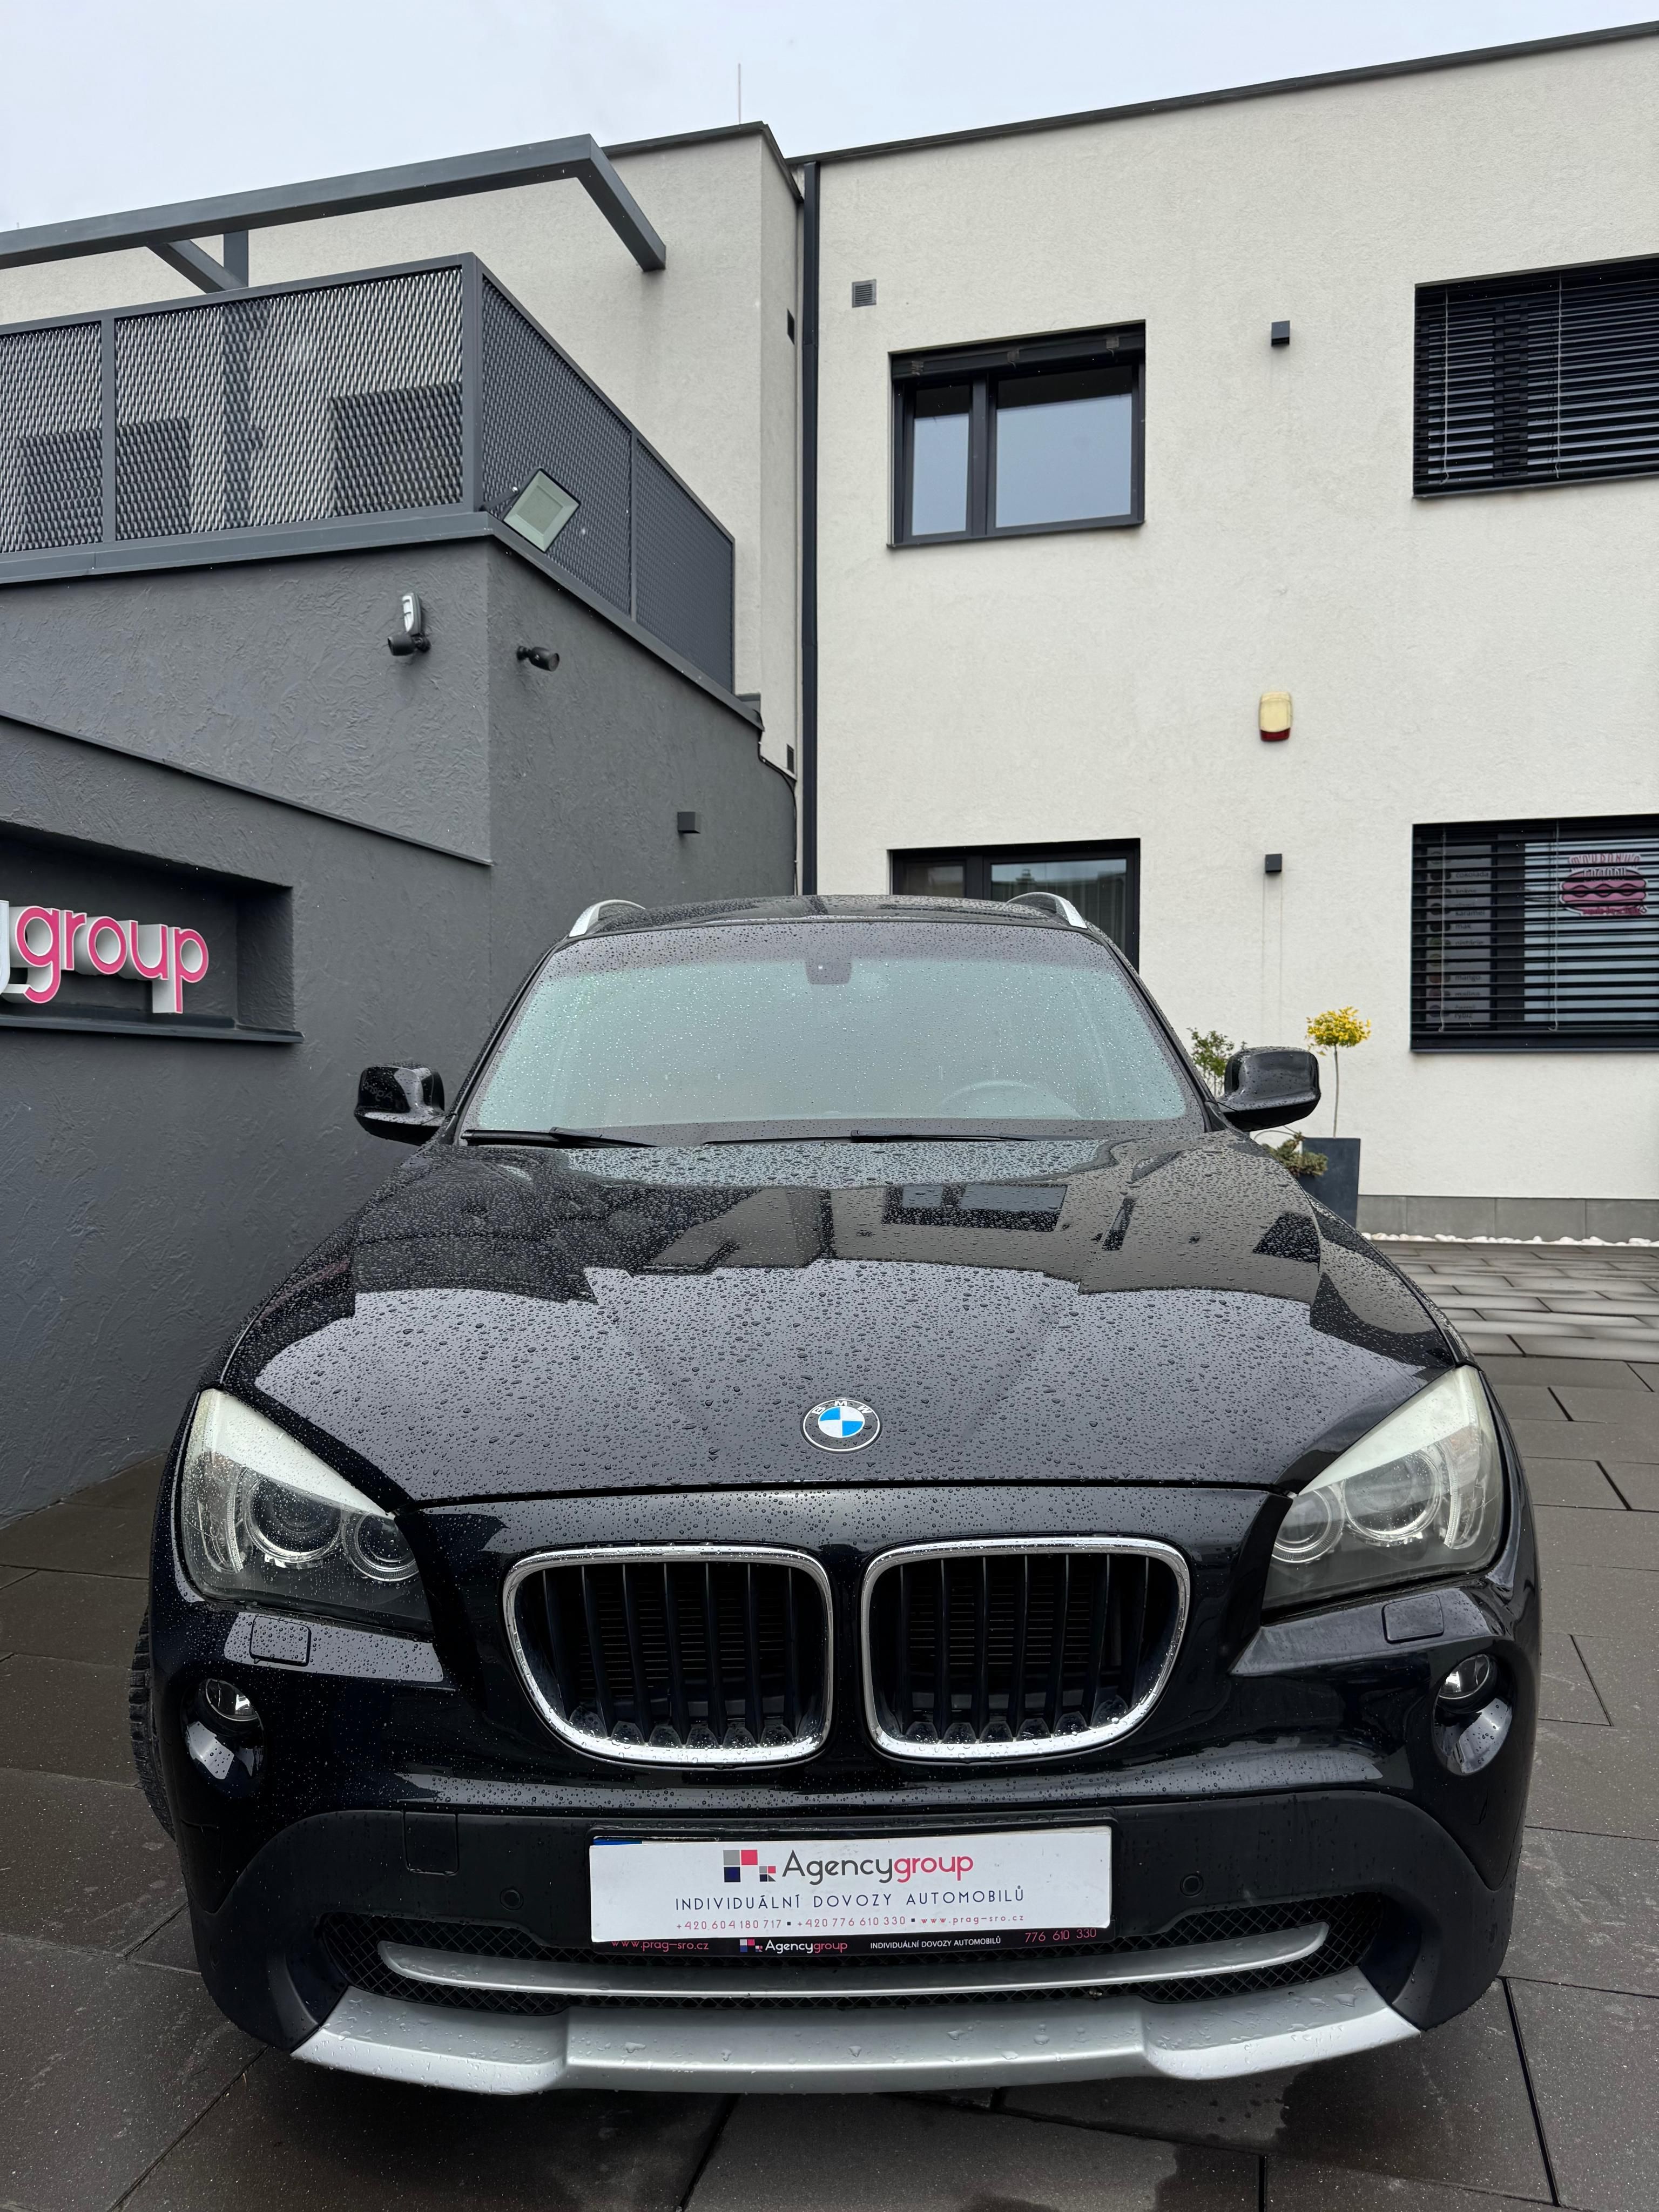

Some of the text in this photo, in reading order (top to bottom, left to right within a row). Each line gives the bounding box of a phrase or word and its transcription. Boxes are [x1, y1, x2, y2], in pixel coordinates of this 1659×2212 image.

[811, 1400, 873, 1415] BMW
[782, 1849, 974, 1885] Agencygroup
[676, 1885, 1023, 1910] INDIVIDUÁLNÍ DOVOZY AUTOMOBILŮ
[832, 1917, 854, 1927] 776
[860, 1917, 879, 1926] 610
[884, 1916, 905, 1925] 330
[921, 1915, 1024, 1925] www.prag-sro.cz
[870, 1935, 1001, 1949] INDIVIDUÁLNÍ DOVOZY AUTOMOBILŮ
[1025, 1927, 1097, 1943] 776 610 330
[611, 1939, 709, 1952] www.prag-sro.cz
[765, 1939, 848, 1954] Agencygroup
